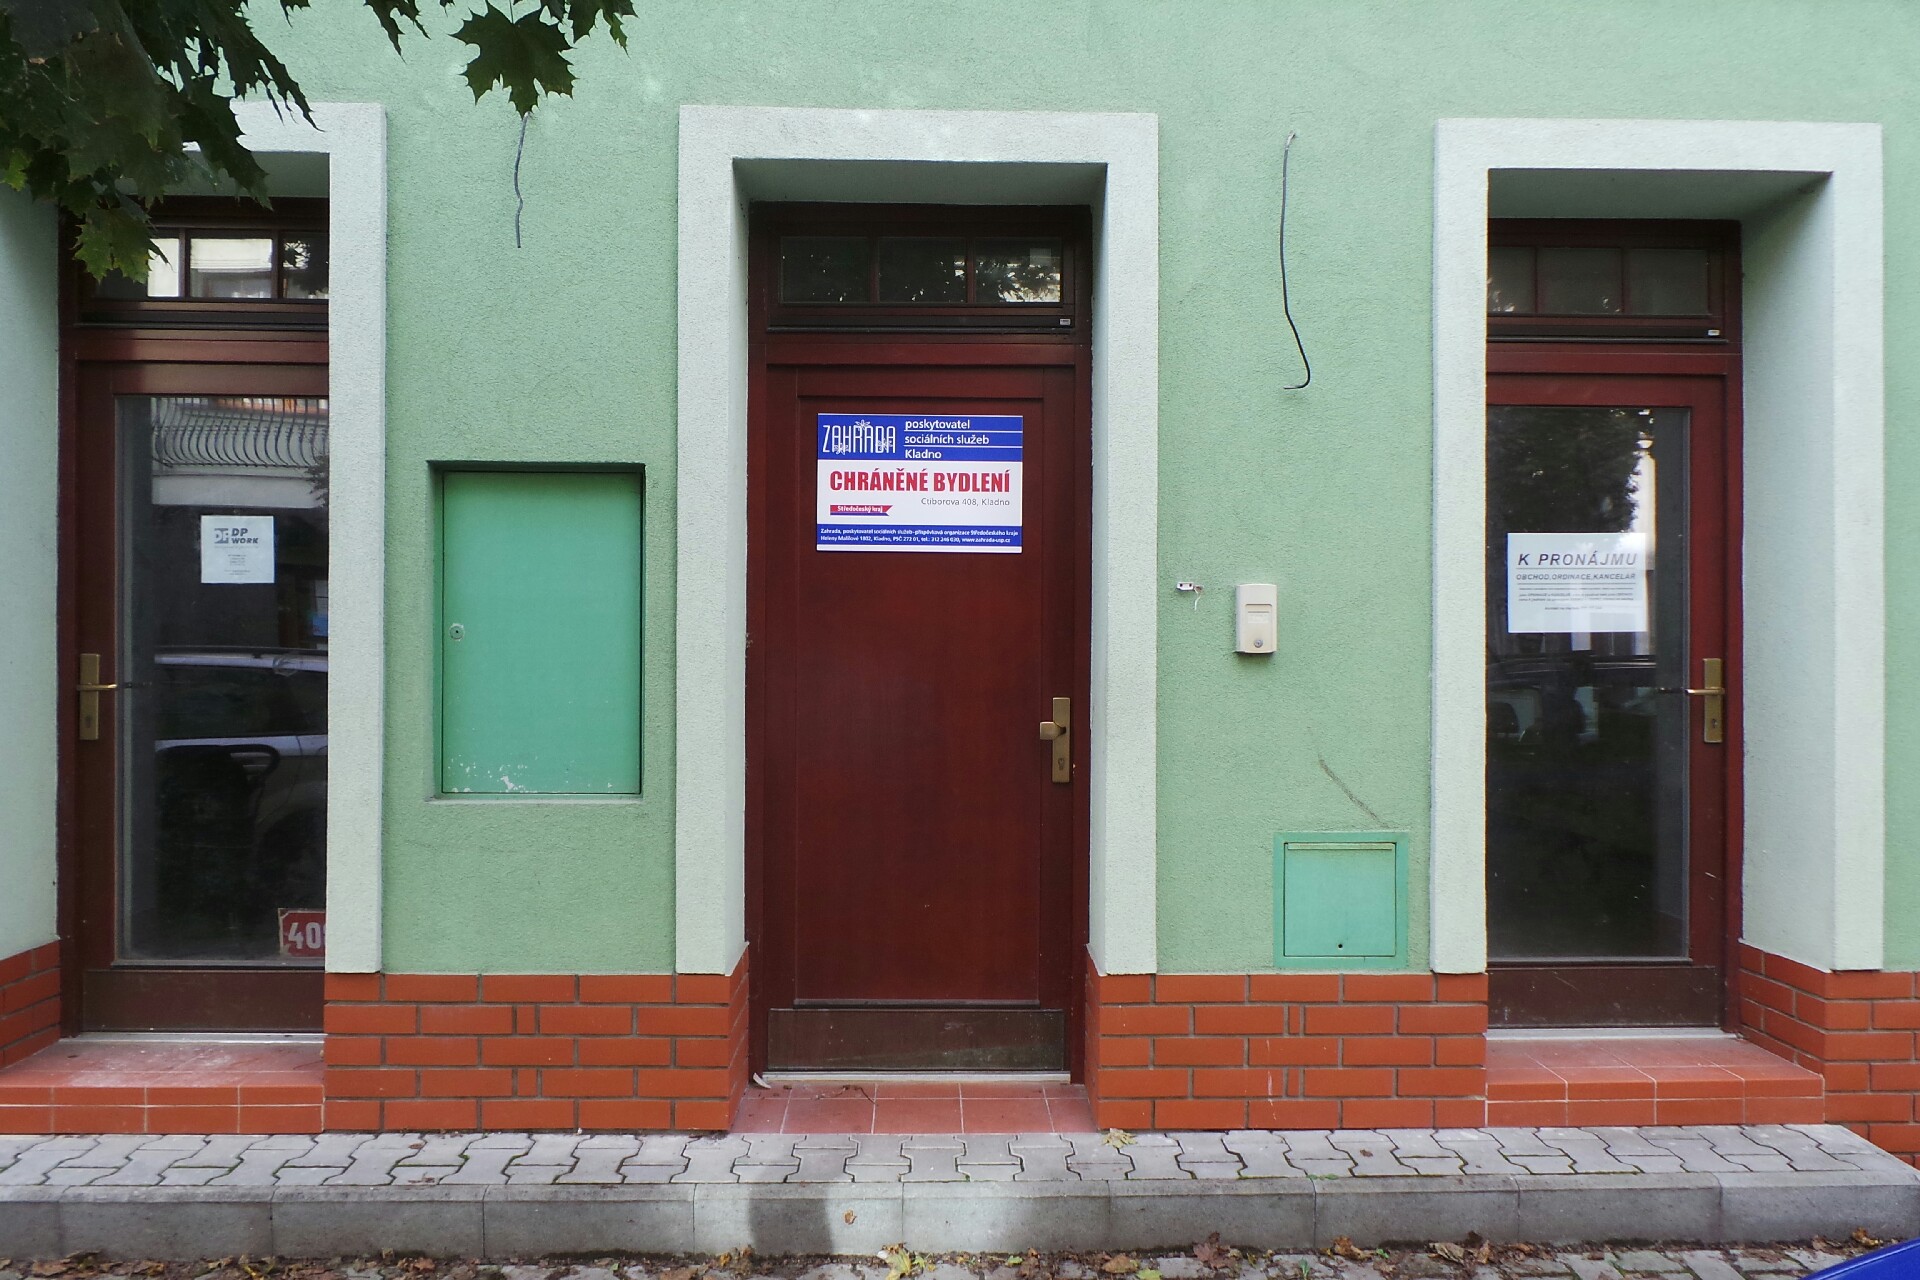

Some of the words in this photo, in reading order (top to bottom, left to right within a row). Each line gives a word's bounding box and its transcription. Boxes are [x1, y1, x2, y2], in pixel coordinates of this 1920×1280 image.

[904, 419, 970, 431] poskytovatel
[822, 421, 896, 455] ZAHRADA
[904, 434, 954, 444] sociálních
[956, 434, 990, 445] služeb
[904, 449, 942, 459] Kladno
[829, 467, 929, 492] CHRÁNĚNÉ
[933, 469, 1011, 493] BYDLENÍ
[921, 497, 960, 506] Ctiborova
[962, 498, 979, 507] 408,
[982, 498, 1010, 506] Kladno
[837, 505, 872, 513] Středočeský
[872, 505, 883, 513] kraj
[231, 527, 249, 537] DP
[1517, 553, 1530, 566] K
[1537, 550, 1637, 566] PRONÁJMU
[288, 921, 326, 950] 40
